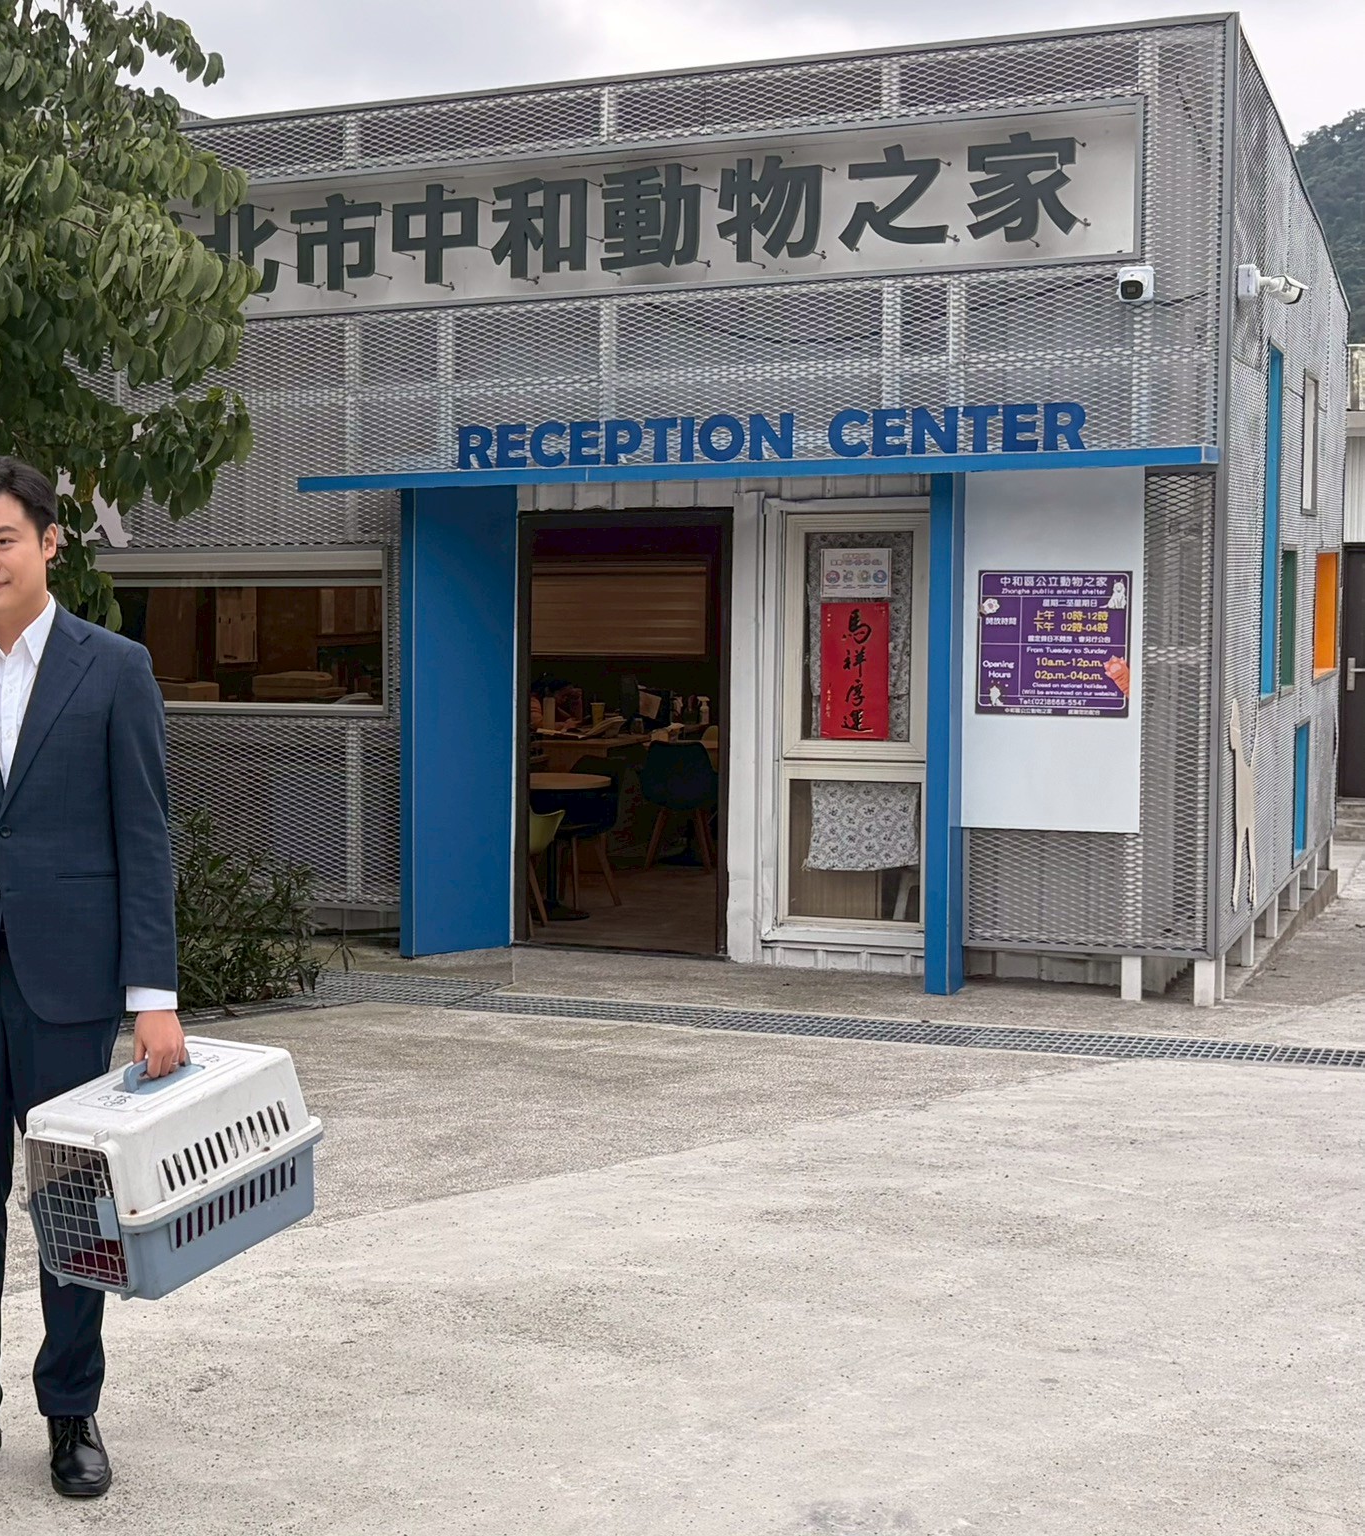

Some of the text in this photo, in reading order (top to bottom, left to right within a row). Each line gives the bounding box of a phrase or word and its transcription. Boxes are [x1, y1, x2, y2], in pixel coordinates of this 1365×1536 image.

[169, 131, 1077, 294] 北市中和動物之家
[457, 402, 1087, 470] RECEPTION CENTER
[1000, 576, 1108, 587] 中和區公立動物之家
[1033, 610, 1055, 620] 上午
[1033, 621, 1055, 632] 下午
[1045, 647, 1072, 655] Tuesday
[982, 660, 1015, 669] Opening
[988, 671, 1012, 679] Hours
